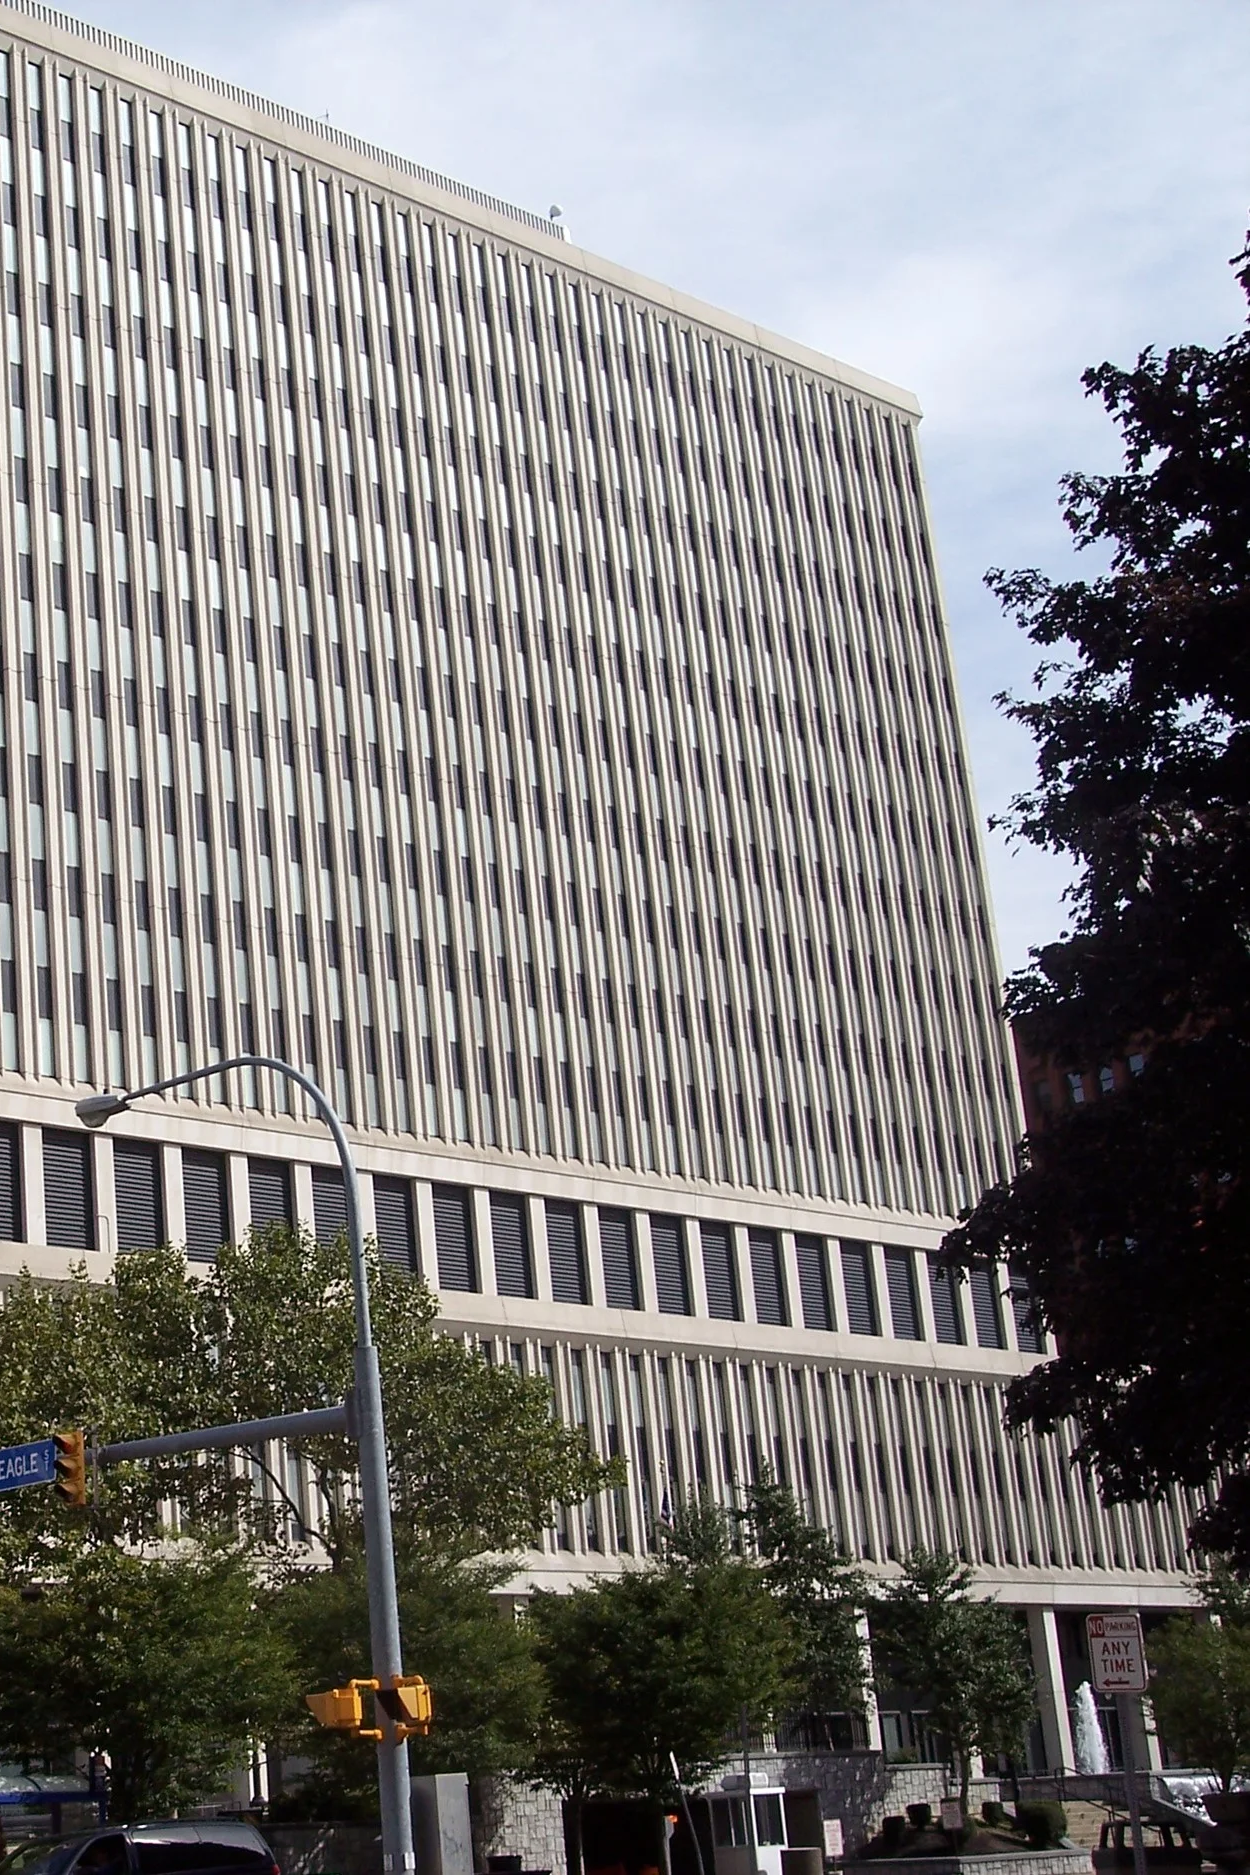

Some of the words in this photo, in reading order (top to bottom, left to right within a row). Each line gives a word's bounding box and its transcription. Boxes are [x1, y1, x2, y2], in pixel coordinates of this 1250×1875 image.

[1089, 1620, 1103, 1635] NO
[1105, 1621, 1137, 1631] PARKING
[1101, 1641, 1130, 1656] ANY
[1101, 1658, 1136, 1673] TIME
